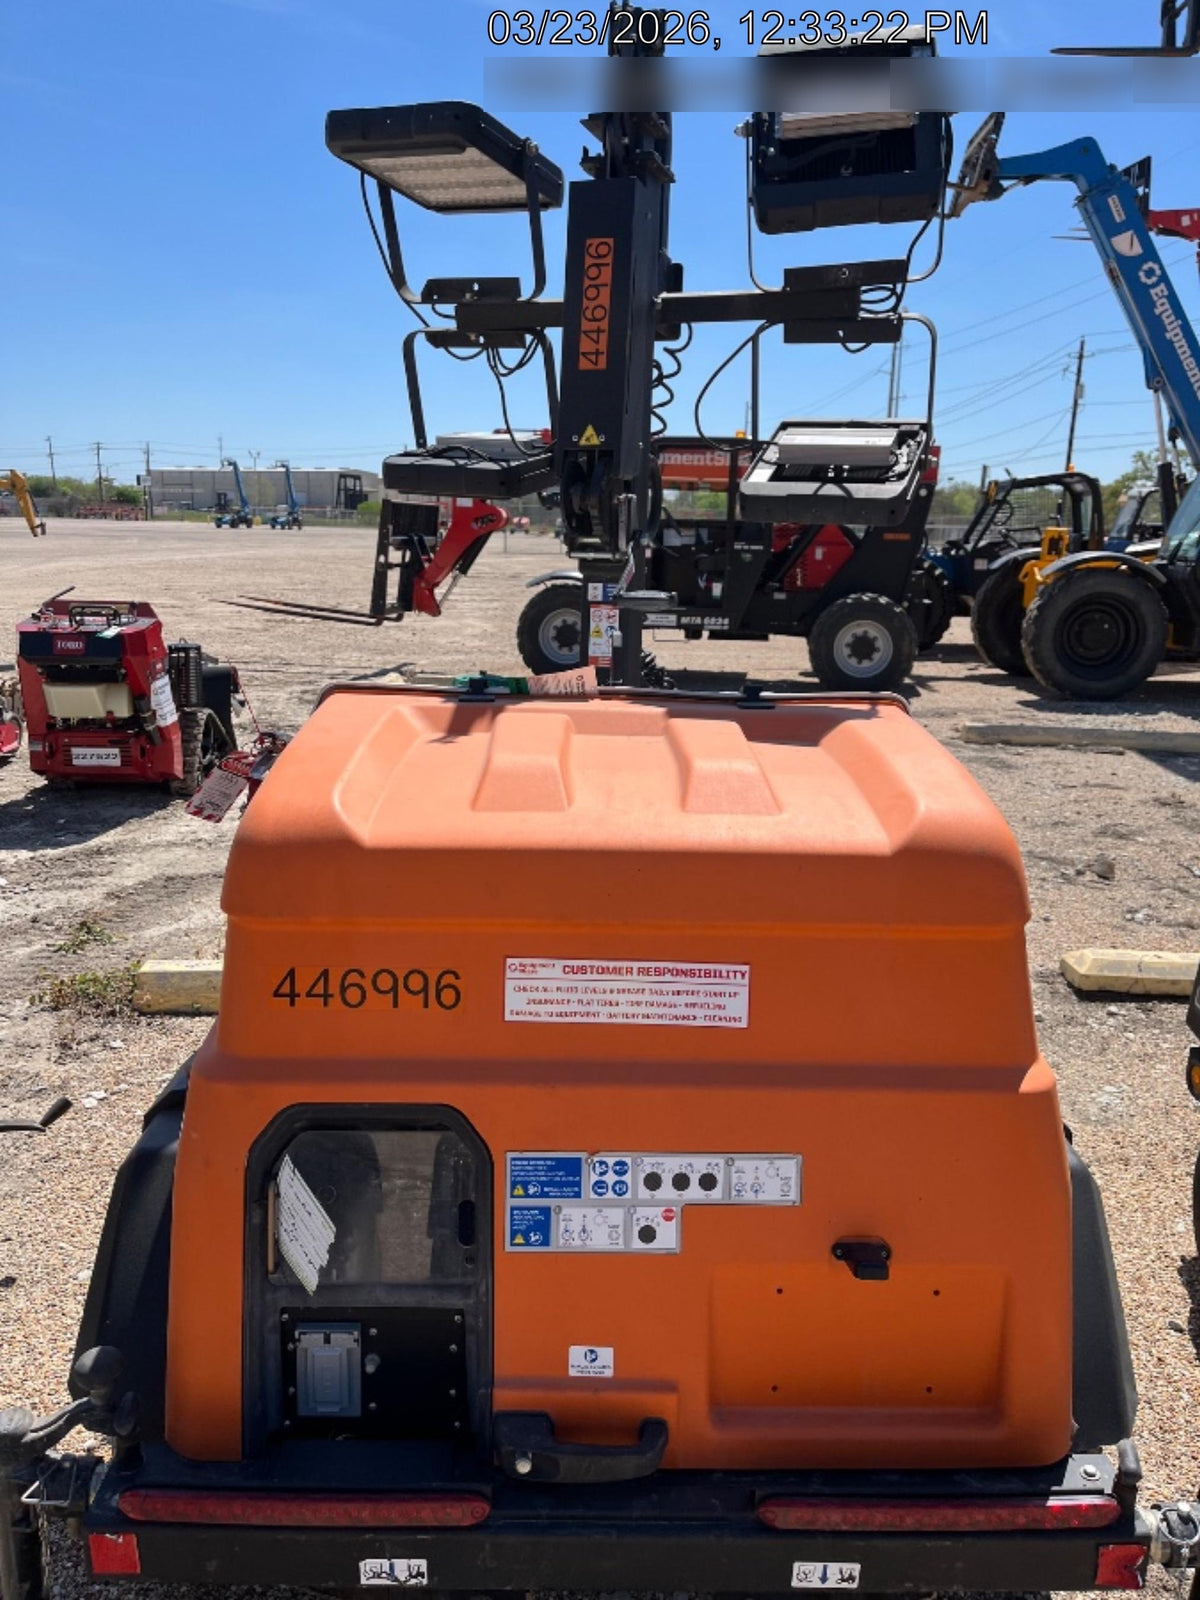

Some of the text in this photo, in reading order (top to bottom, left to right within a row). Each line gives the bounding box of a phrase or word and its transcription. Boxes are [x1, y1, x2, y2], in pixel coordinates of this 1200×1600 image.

[580, 241, 612, 367] 446996
[272, 966, 462, 1011] 446996
[562, 964, 748, 980] CUSTOMER RESPONSIBILITY
